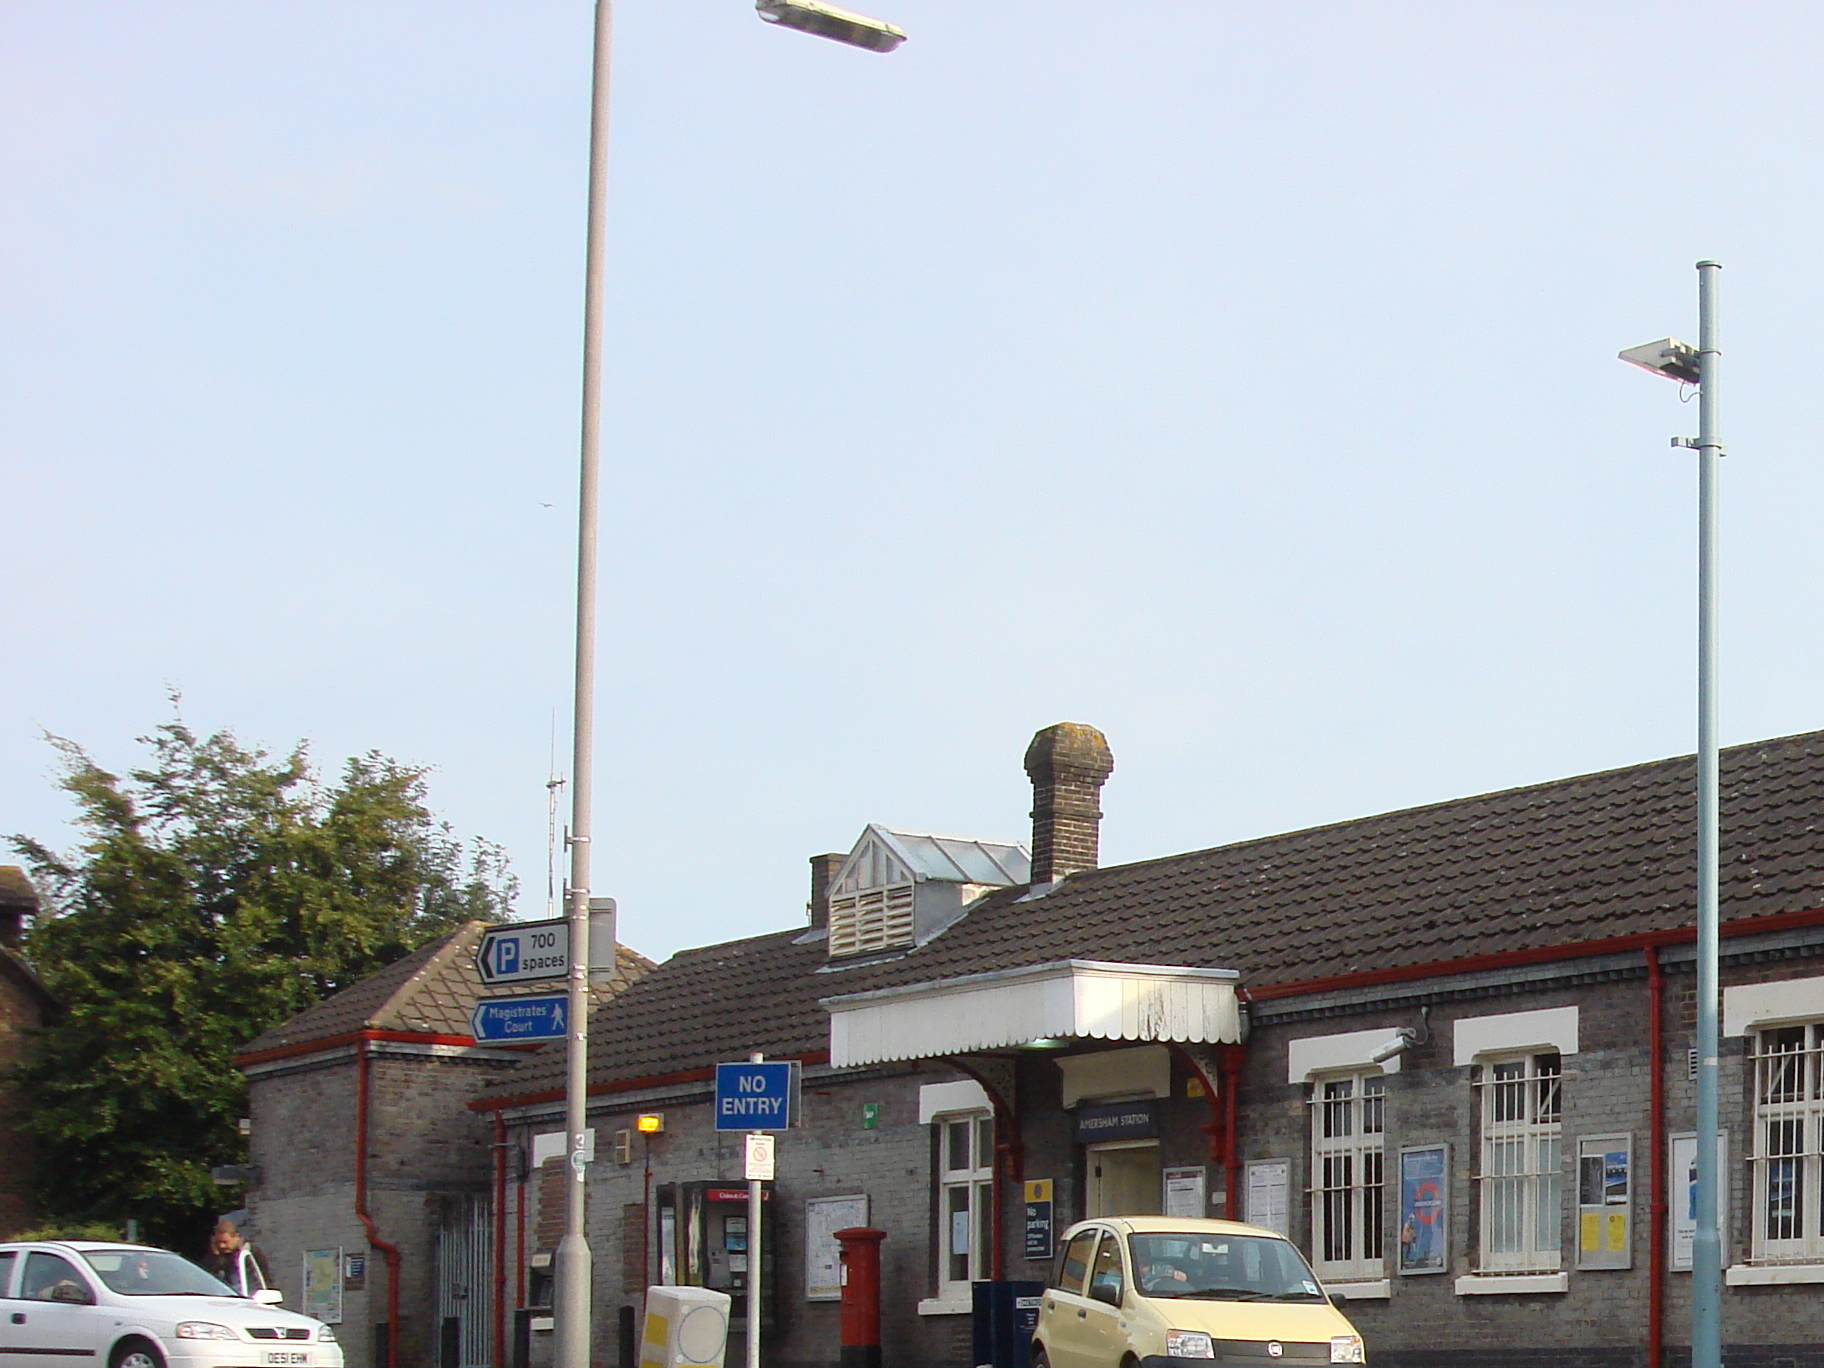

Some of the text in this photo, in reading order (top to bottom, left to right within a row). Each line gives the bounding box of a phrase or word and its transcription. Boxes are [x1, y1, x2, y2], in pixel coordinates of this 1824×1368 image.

[531, 933, 556, 949] 700
[501, 941, 516, 971] P
[522, 955, 565, 972] spaces
[504, 1020, 533, 1033] Court
[739, 1075, 766, 1093] NO
[722, 1097, 783, 1115] ENTRY
[1079, 1113, 1149, 1130] AMERSHAM STATION
[1027, 1207, 1037, 1216] No
[1027, 1219, 1049, 1231] parking
